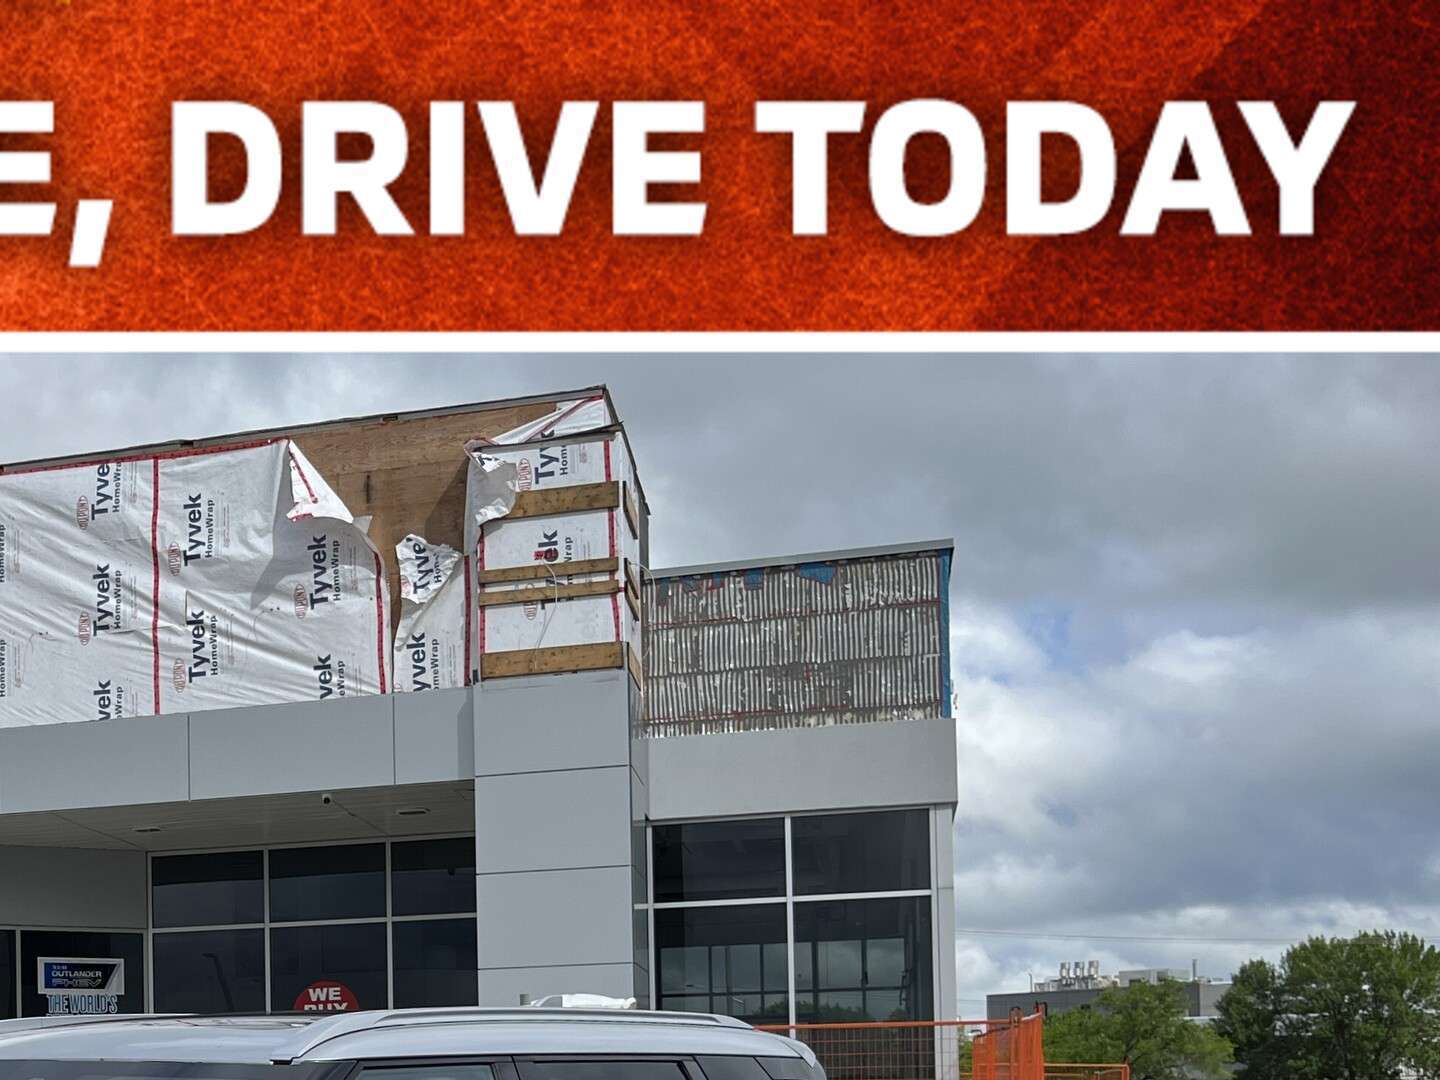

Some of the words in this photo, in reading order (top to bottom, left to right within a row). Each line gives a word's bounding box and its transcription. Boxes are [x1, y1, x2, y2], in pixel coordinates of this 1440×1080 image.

[91, 464, 113, 520] Tyve
[112, 462, 121, 512] HomeWra
[535, 447, 560, 484] Tyv
[183, 493, 206, 567] Tyvek
[204, 500, 215, 558] HomeWrap
[307, 533, 333, 610] Tyvek
[333, 540, 341, 601] HomeWrap
[93, 563, 113, 636] Tyvek
[112, 570, 122, 629] HomeWrap
[186, 610, 210, 683] Tyvek
[210, 615, 219, 676] HomeWrap
[406, 632, 431, 692] yvek
[431, 638, 440, 690] omeWrap
[93, 679, 111, 721] vek
[313, 653, 333, 699] vek
[336, 660, 346, 696] eWrap
[51, 970, 102, 978] OUTLANDER
[308, 987, 342, 1002] WE
[47, 994, 68, 1014] THE
[69, 994, 118, 1014] WORLD'S
